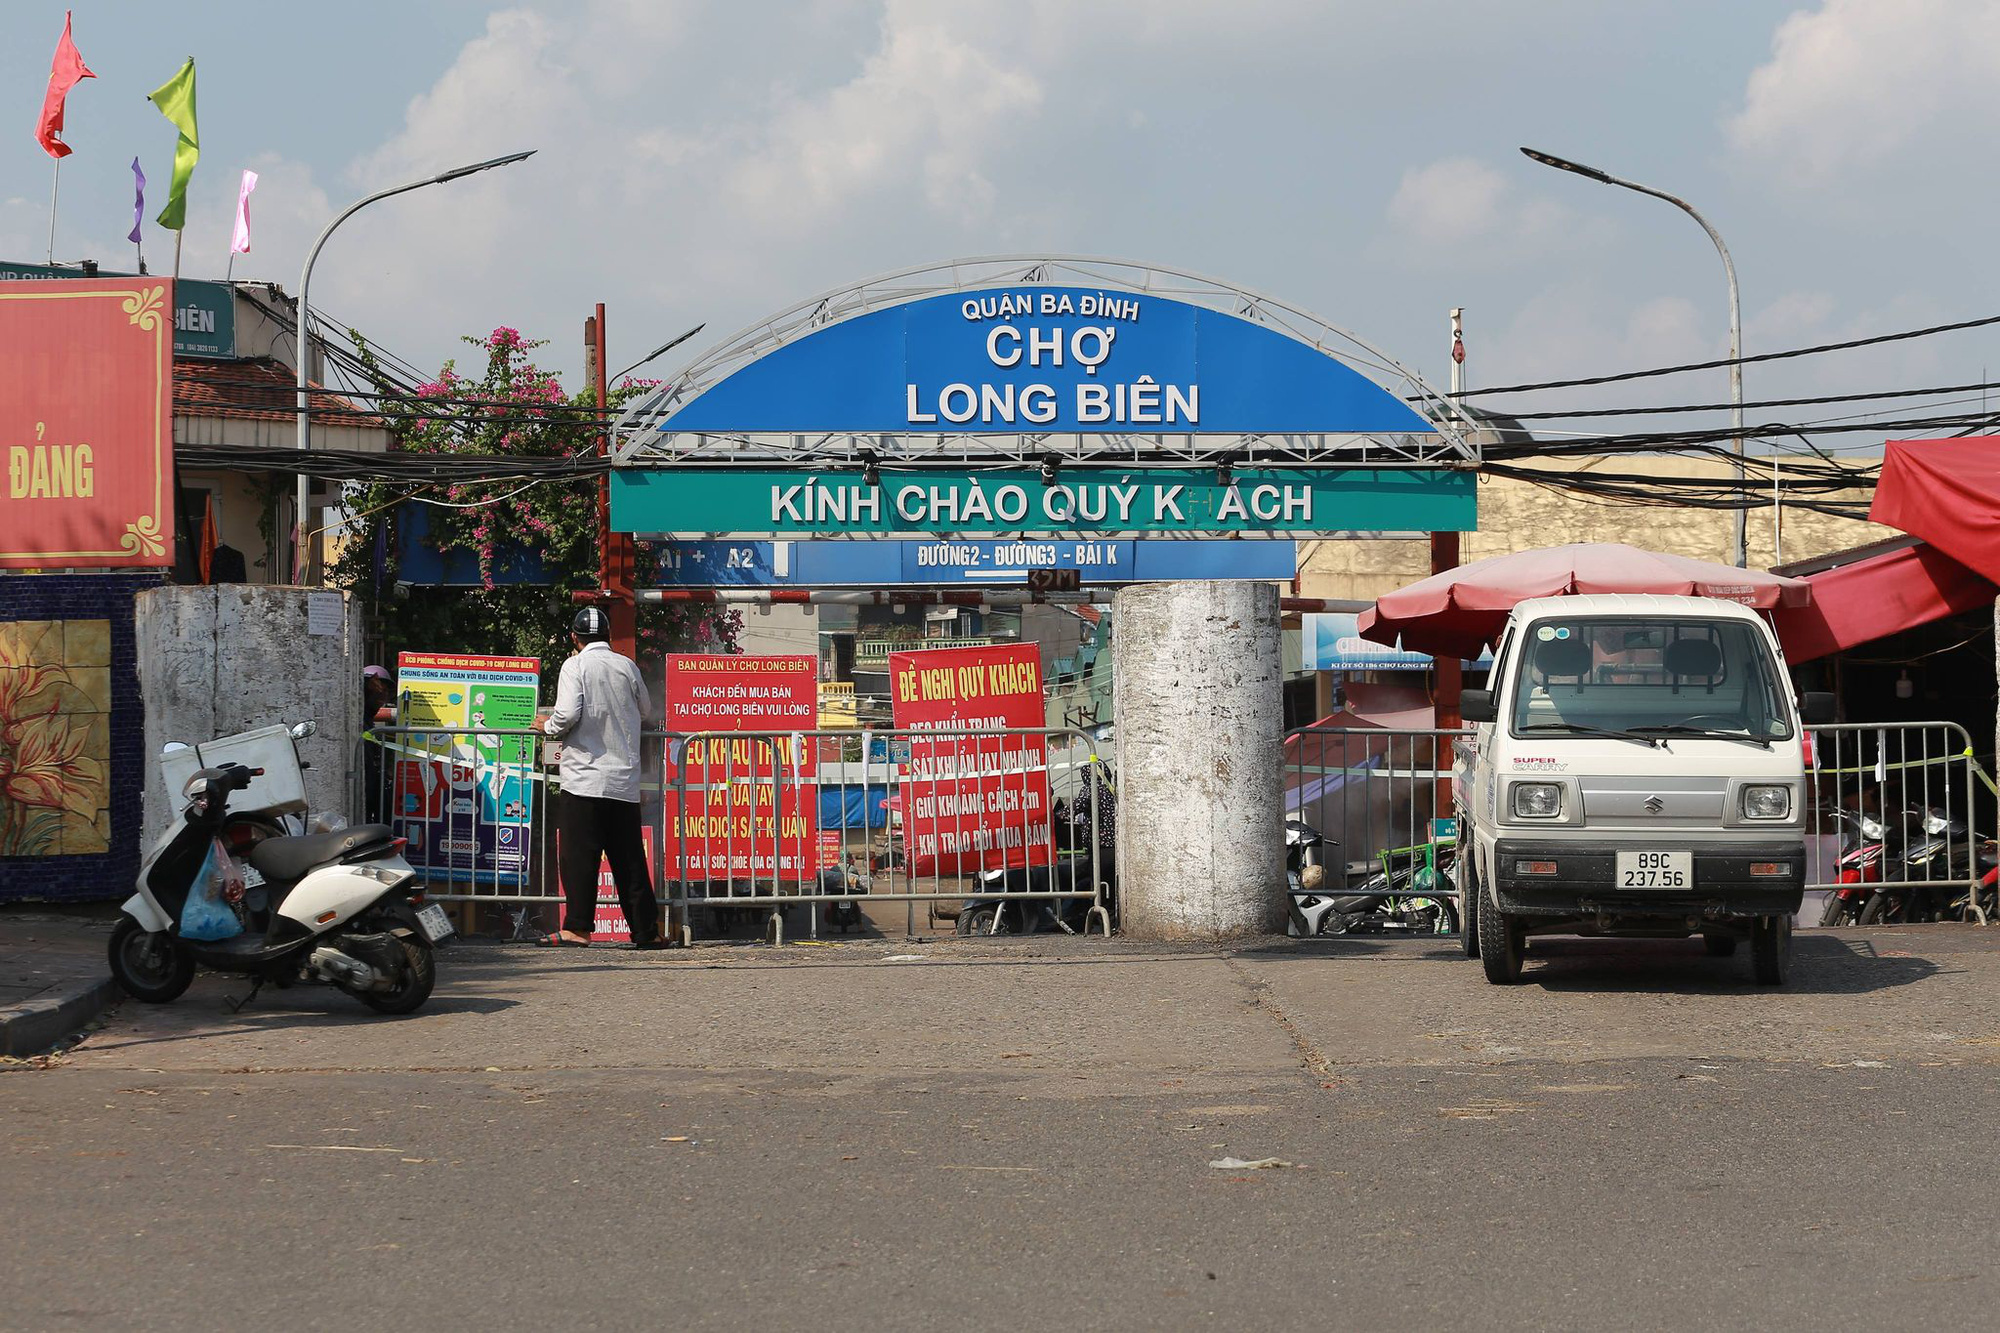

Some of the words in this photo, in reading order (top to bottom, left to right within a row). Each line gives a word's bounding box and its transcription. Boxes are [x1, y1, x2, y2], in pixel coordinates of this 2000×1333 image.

[961, 292, 1032, 321] QUẬN
[1040, 294, 1075, 315] BA
[1079, 292, 1140, 322] ĐÌNH
[986, 324, 1117, 374] CHỢ
[906, 383, 1058, 423] LONG
[1076, 374, 1200, 423] BIÊN
[8, 421, 95, 499] ĐẢNG
[771, 476, 881, 523] KÍNH
[896, 476, 1029, 522] CHÀO
[1042, 475, 1140, 524] QUÝ
[726, 547, 755, 569] A2
[1075, 540, 1102, 566] BÃI
[1106, 545, 1118, 565] K
[678, 660, 697, 670] BAN
[699, 658, 724, 671] QUẢN
[726, 658, 738, 671] LÝ
[739, 660, 761, 673] CHỢ
[761, 661, 786, 671] LONG
[788, 658, 809, 671] BIÊN
[692, 684, 726, 698] KHÁCH
[727, 682, 747, 698] ĐẾN
[749, 686, 770, 698] MUA
[772, 684, 792, 699] BÁN
[898, 659, 919, 703] ĐỀ
[920, 667, 957, 707] NGHỊ
[958, 659, 986, 702] QUÝ
[988, 656, 1038, 696] KHÁCH
[674, 703, 689, 718] TẠI
[691, 703, 712, 718] CHỢ
[714, 703, 740, 715] LONG
[742, 701, 764, 716] BIÊN
[766, 704, 782, 716] VUI
[783, 701, 810, 716] LÒNG
[912, 752, 933, 778] SÁT
[1003, 748, 1041, 771] NHANH
[1512, 763, 1569, 772] CARRY
[987, 786, 1019, 814] CÁCH
[711, 851, 727, 870] SỨC
[1638, 853, 1670, 869] 89C
[1624, 871, 1684, 887] 237.56
